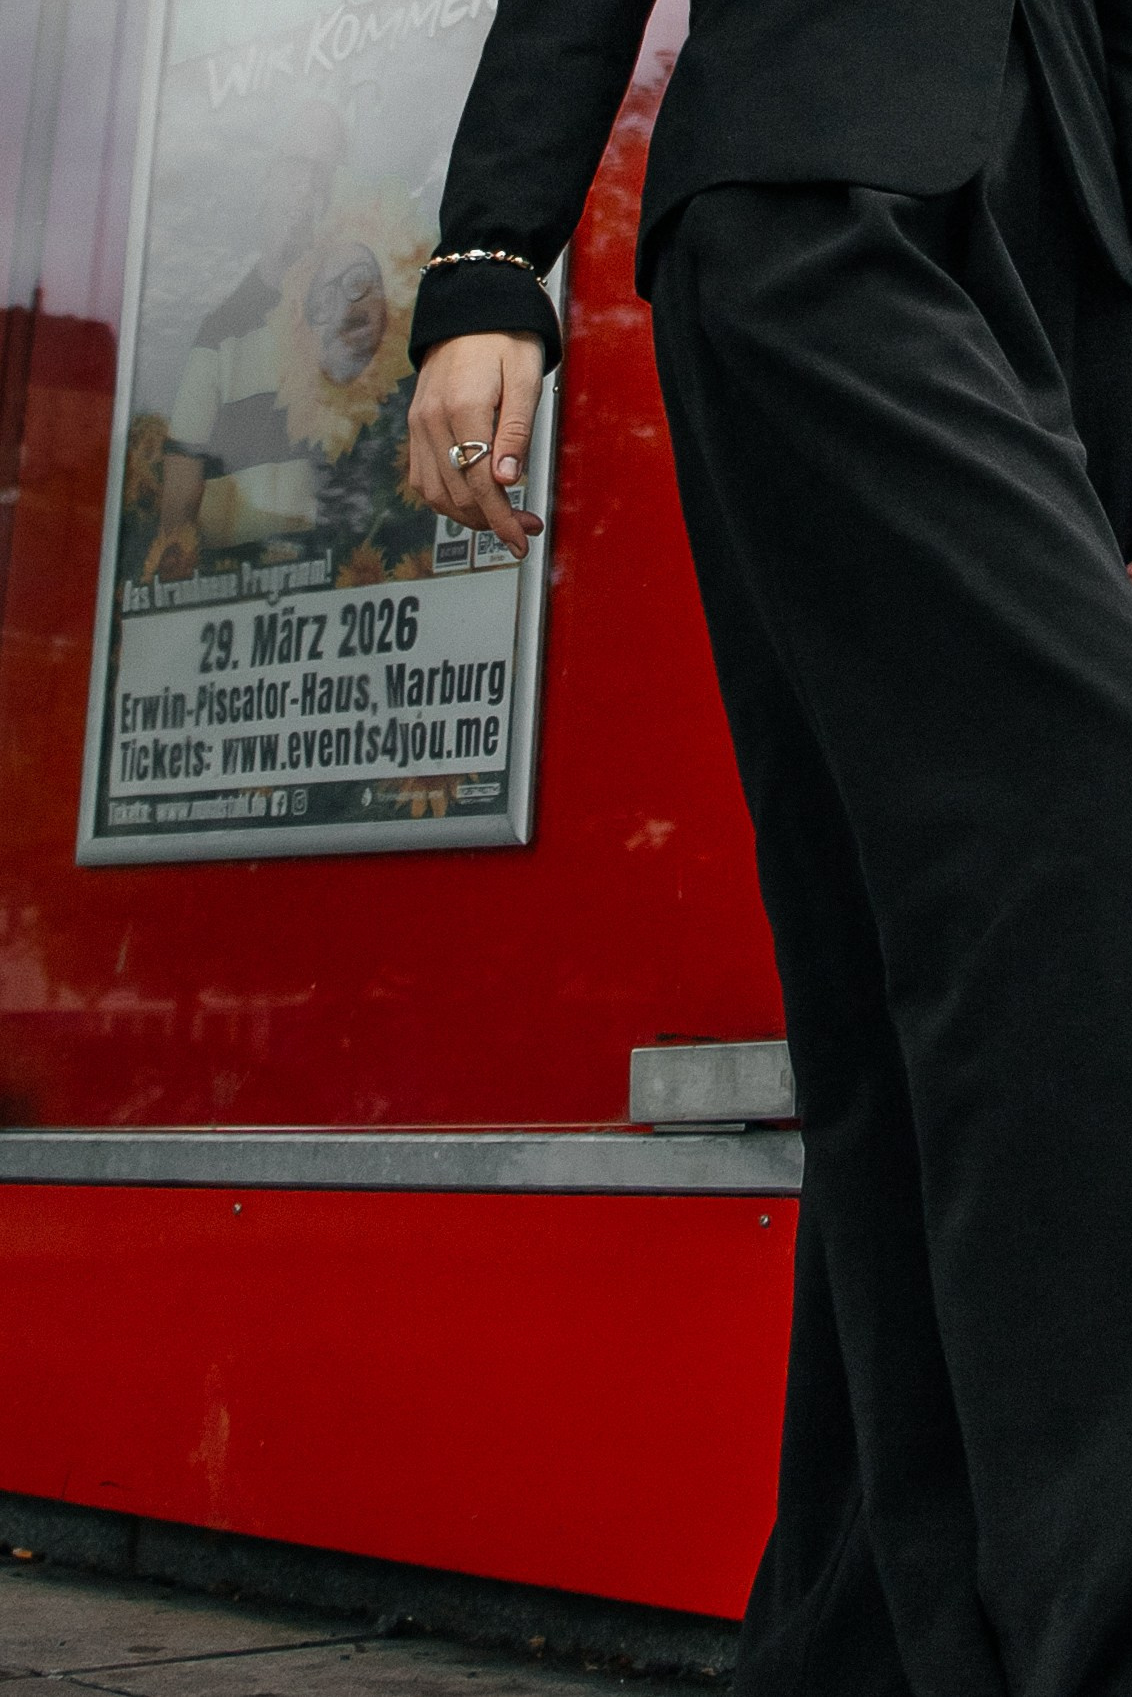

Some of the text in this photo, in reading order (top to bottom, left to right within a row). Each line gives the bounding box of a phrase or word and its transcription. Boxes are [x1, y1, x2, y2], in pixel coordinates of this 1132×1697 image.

[199, 595, 420, 673] 29. März 2026
[120, 659, 506, 734] Erwin-Piscator-Haus, Marburg
[120, 711, 500, 784] Tickets: www.events4you.me
